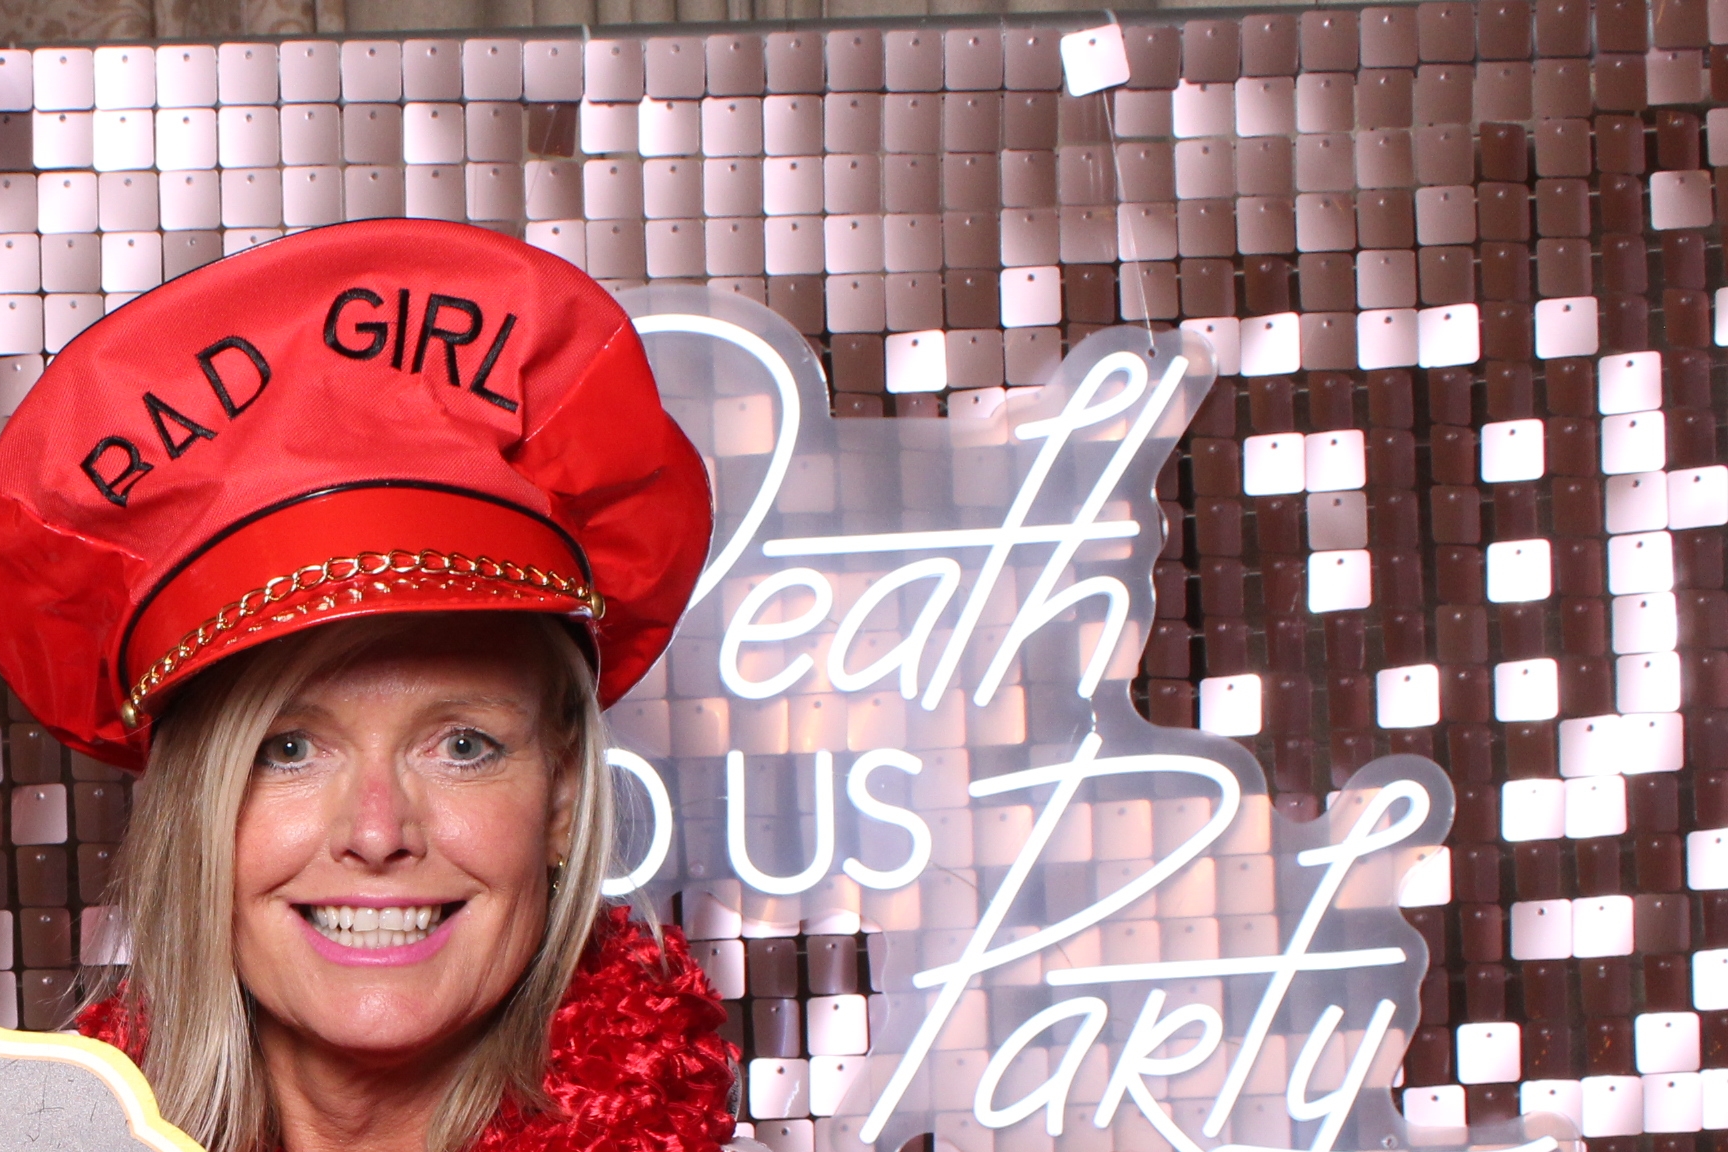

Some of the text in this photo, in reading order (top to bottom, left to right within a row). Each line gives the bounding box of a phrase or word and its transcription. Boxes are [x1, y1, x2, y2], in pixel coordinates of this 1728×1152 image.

[79, 287, 519, 507] BAD GIRL
[726, 748, 933, 896] US
